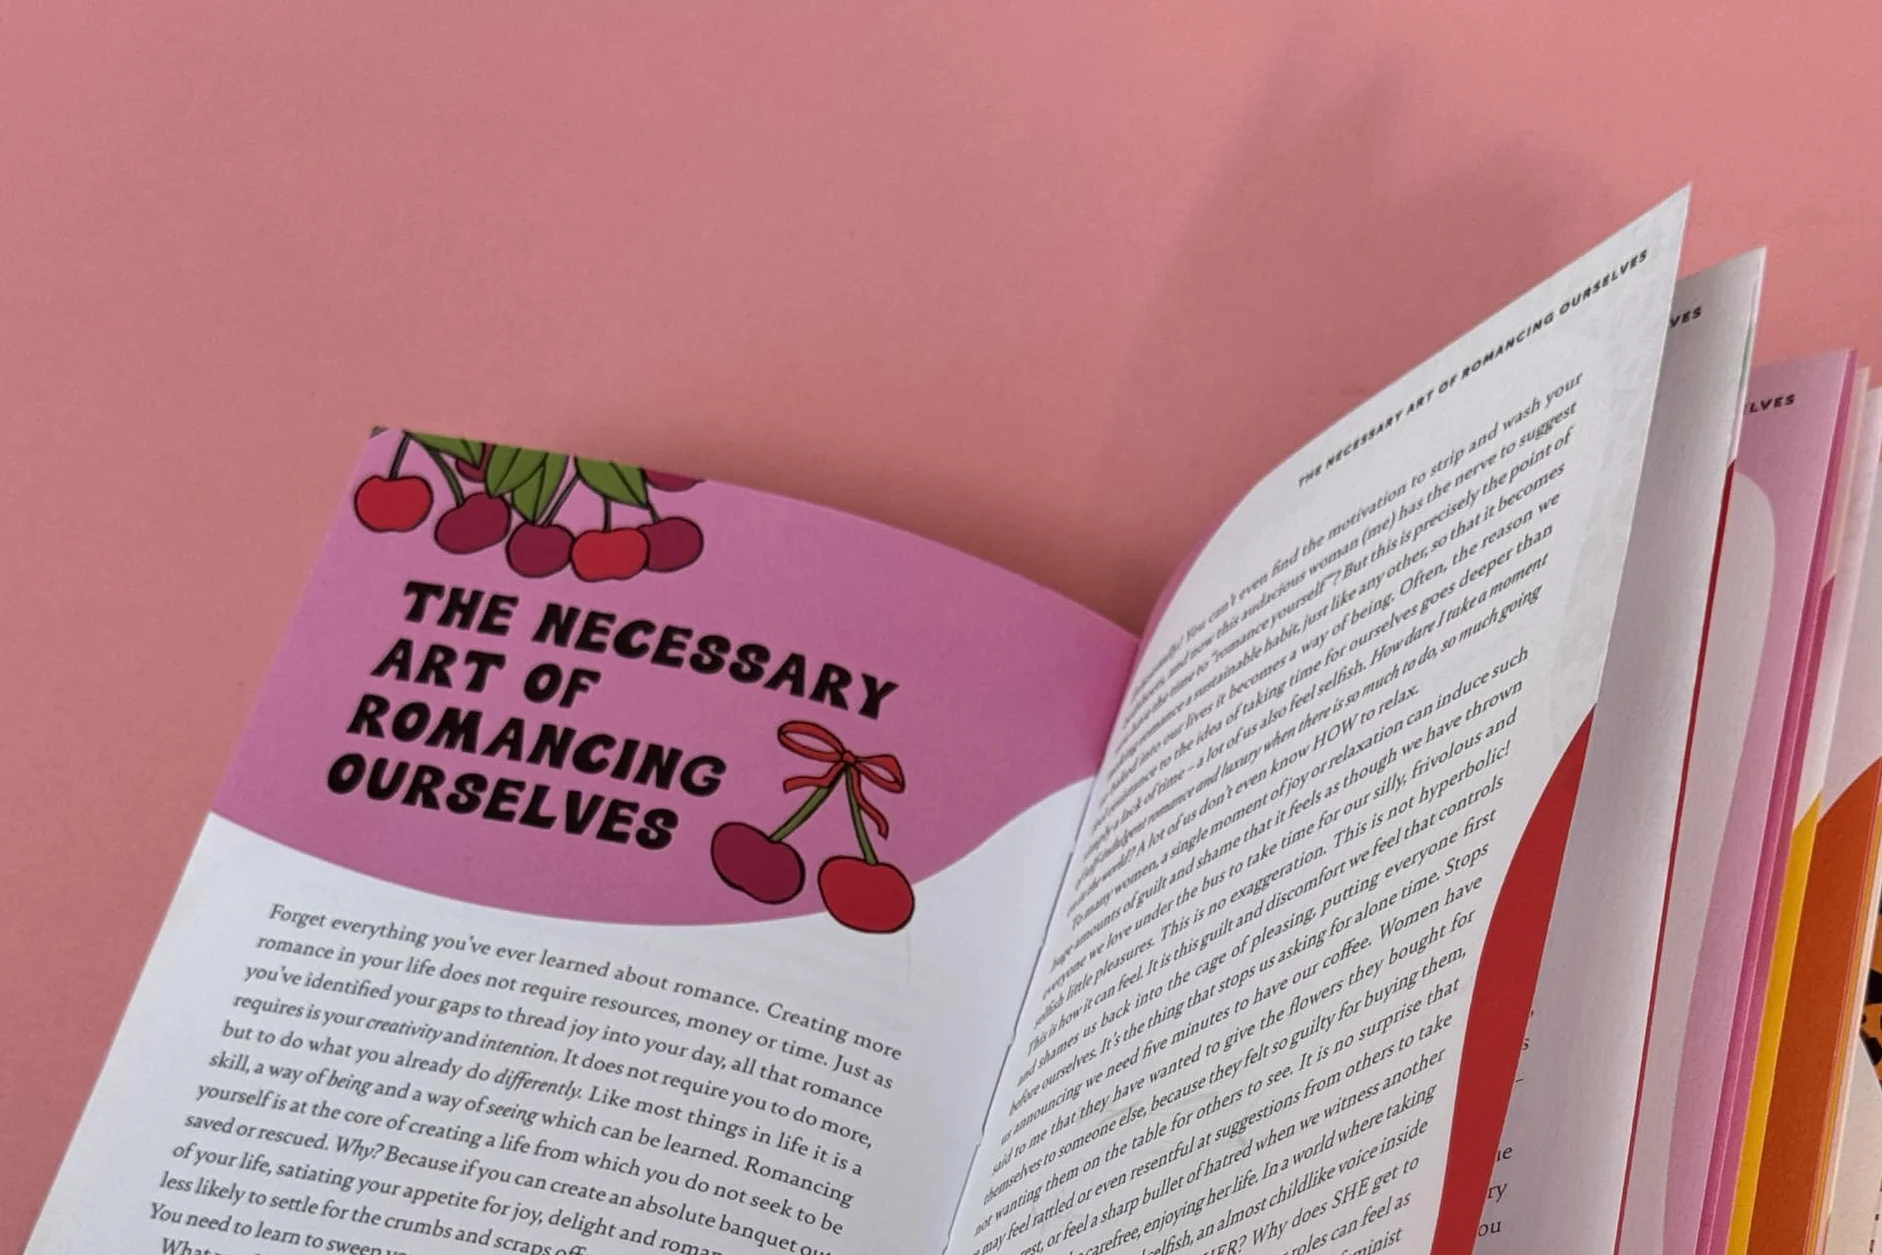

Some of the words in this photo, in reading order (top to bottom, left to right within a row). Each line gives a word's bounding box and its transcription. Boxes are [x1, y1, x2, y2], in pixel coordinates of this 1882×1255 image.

[1299, 464, 1322, 488] THE
[1325, 409, 1404, 470] NECESSARY
[1406, 389, 1435, 416] ART
[1438, 374, 1459, 395] OF
[1460, 312, 1554, 380] ROMANCING
[1559, 249, 1648, 315] OURSELVES
[370, 638, 506, 693] ART
[523, 663, 601, 708] OF
[404, 581, 518, 636] THE
[532, 603, 900, 721] NECESSARY
[327, 753, 679, 850] OURSELVES
[346, 693, 727, 797] ROMANCING
[1066, 974, 1093, 1000] little
[1094, 938, 1154, 985] pleasures.
[1161, 916, 1190, 941] This
[1193, 909, 1204, 923] is
[1208, 898, 1226, 915] no
[1230, 847, 1326, 902] exaggeration.
[1334, 823, 1367, 848] This
[1371, 813, 1383, 829] is
[1387, 796, 1415, 820] not
[1418, 739, 1510, 803] hyperbolic!
[257, 938, 334, 959] romance
[337, 947, 356, 963] in
[360, 955, 403, 970] your
[406, 957, 435, 976] life
[440, 963, 481, 984] does
[485, 976, 517, 991] not
[521, 983, 586, 1004] require
[591, 996, 680, 1026] resources,
[686, 1017, 752, 1045] money
[757, 1036, 777, 1048] or
[782, 1041, 827, 1066] time.
[832, 1054, 870, 1080] Just
[874, 1075, 893, 1089] as
[269, 904, 326, 928] Forget
[331, 919, 429, 948] everything
[432, 935, 491, 955] you've
[496, 947, 536, 962] ever
[539, 949, 610, 977] learned
[614, 966, 668, 990] about
[674, 983, 759, 1013] romance.
[767, 1003, 849, 1044] Creating
[853, 1035, 901, 1060] more
[1253, 1221, 1288, 1245] Why
[1292, 1202, 1327, 1227] does
[1332, 1176, 1370, 1209] SHE
[1372, 1166, 1398, 1195] get
[1403, 1157, 1419, 1174] to
